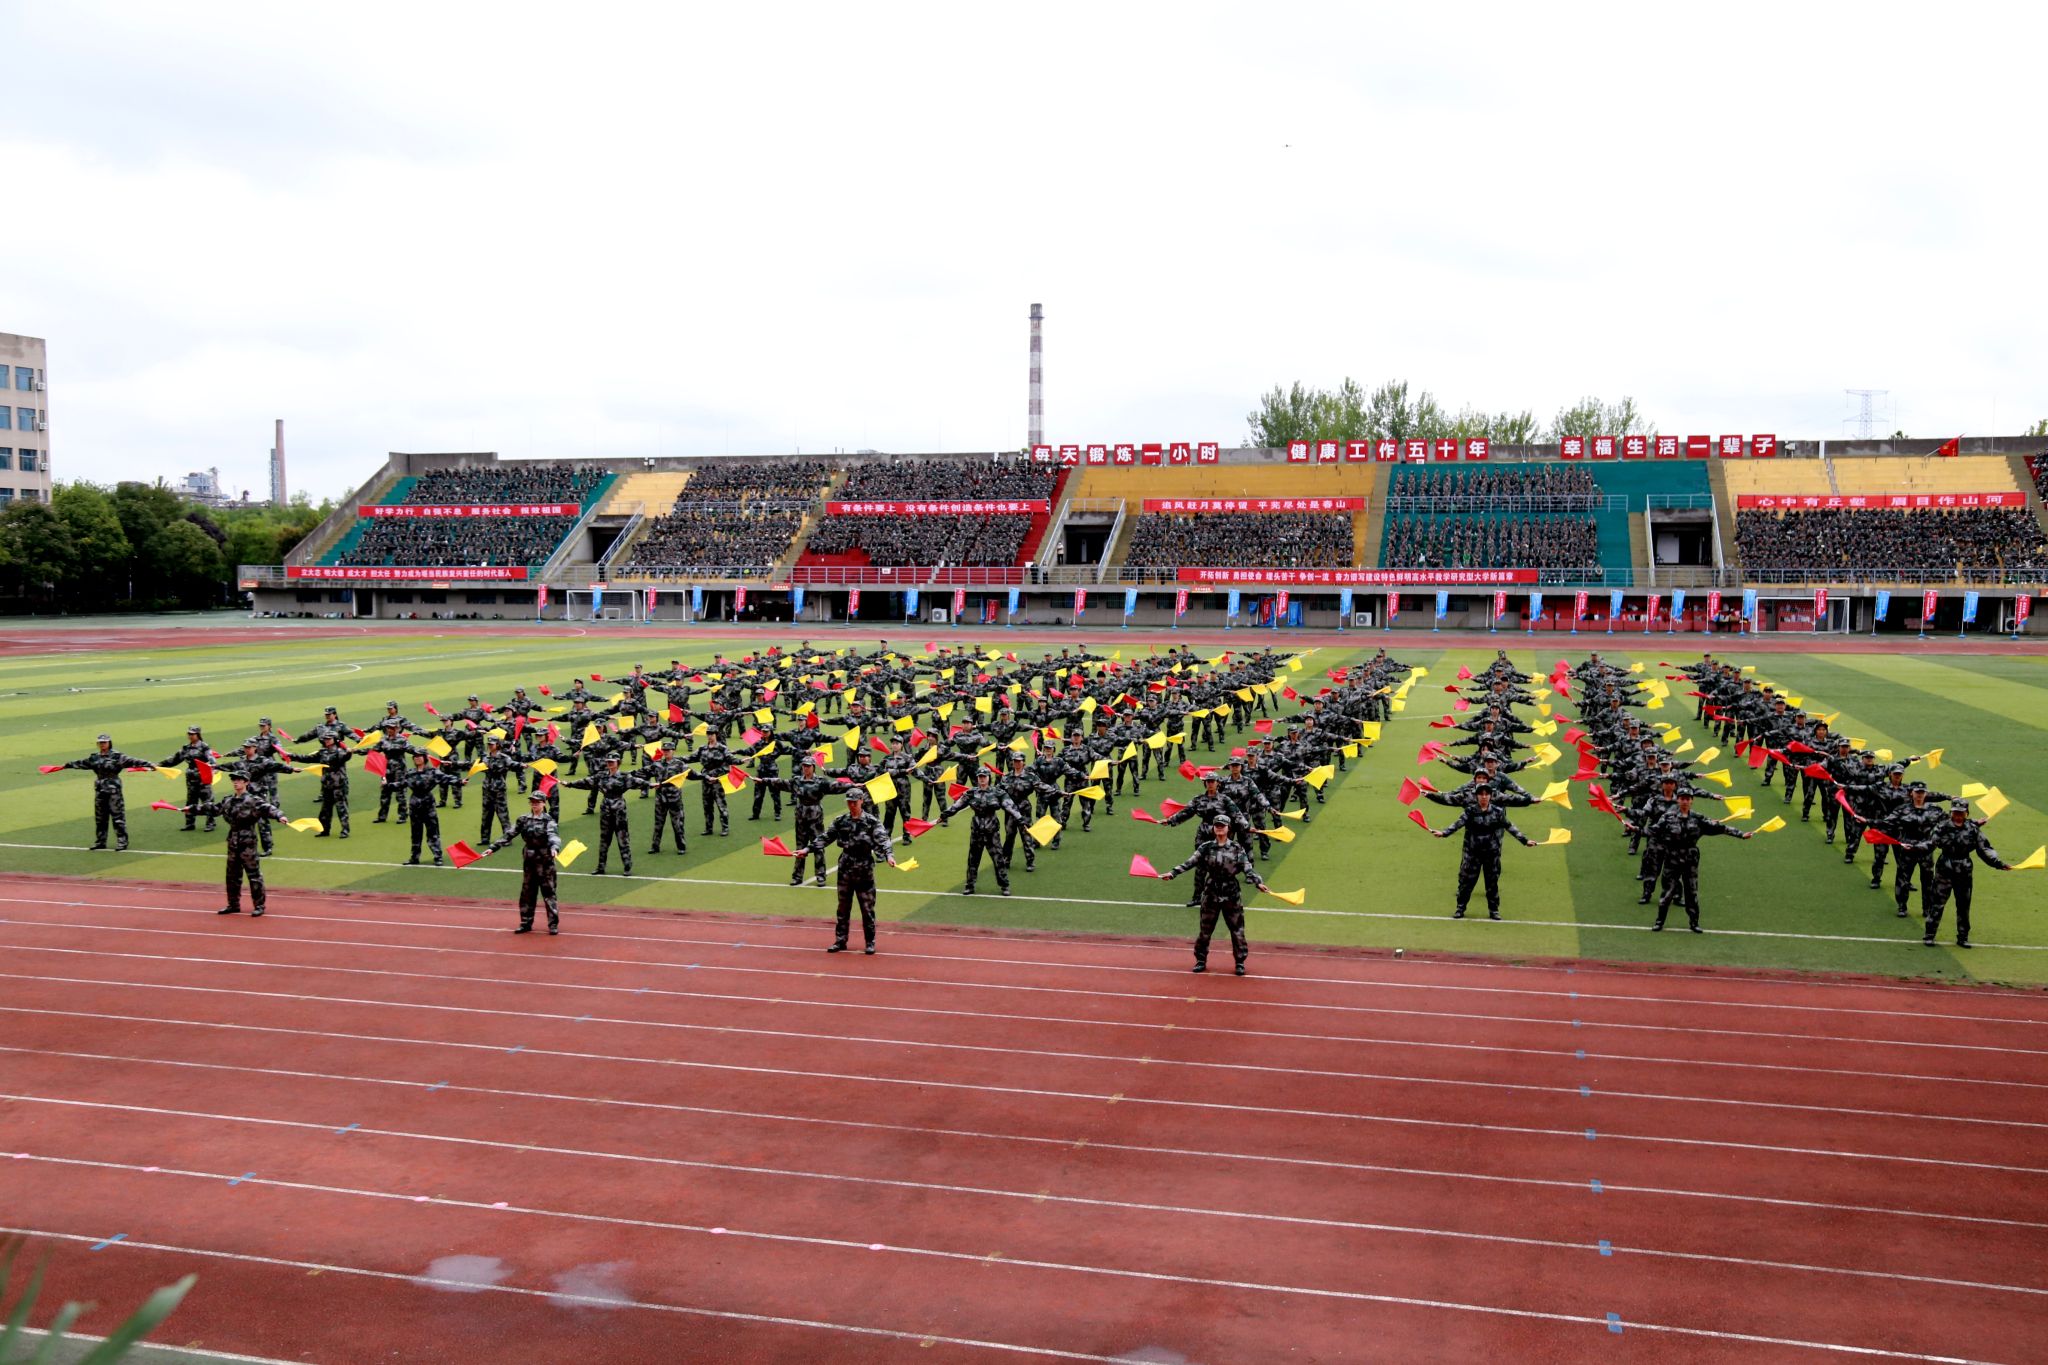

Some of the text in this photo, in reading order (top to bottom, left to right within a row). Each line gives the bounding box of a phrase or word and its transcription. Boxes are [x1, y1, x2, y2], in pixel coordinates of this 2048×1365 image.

[1035, 437, 1774, 462] 每天锻炼一小时 健康工作五十年 幸福生活一辈子
[1162, 500, 1346, 510] 追风赶月莫停留 平芜尽处是春山
[1758, 495, 2004, 506] 心中有丘壑 眉目作山河
[374, 506, 562, 516] 好学力行 自强不息 服务社会 报效祖国
[841, 502, 1031, 512] 有条件要上 没有条件创造条件也要上
[301, 569, 322, 577] 立大志
[323, 569, 345, 577] 明大德
[347, 569, 368, 577] 成大才
[370, 569, 391, 578] 担大任
[1200, 571, 1230, 580] 开拓创新
[1233, 571, 1262, 581] 勇担使命
[1266, 571, 1296, 581] 埋头苦干
[1300, 571, 1330, 581] 争创一流
